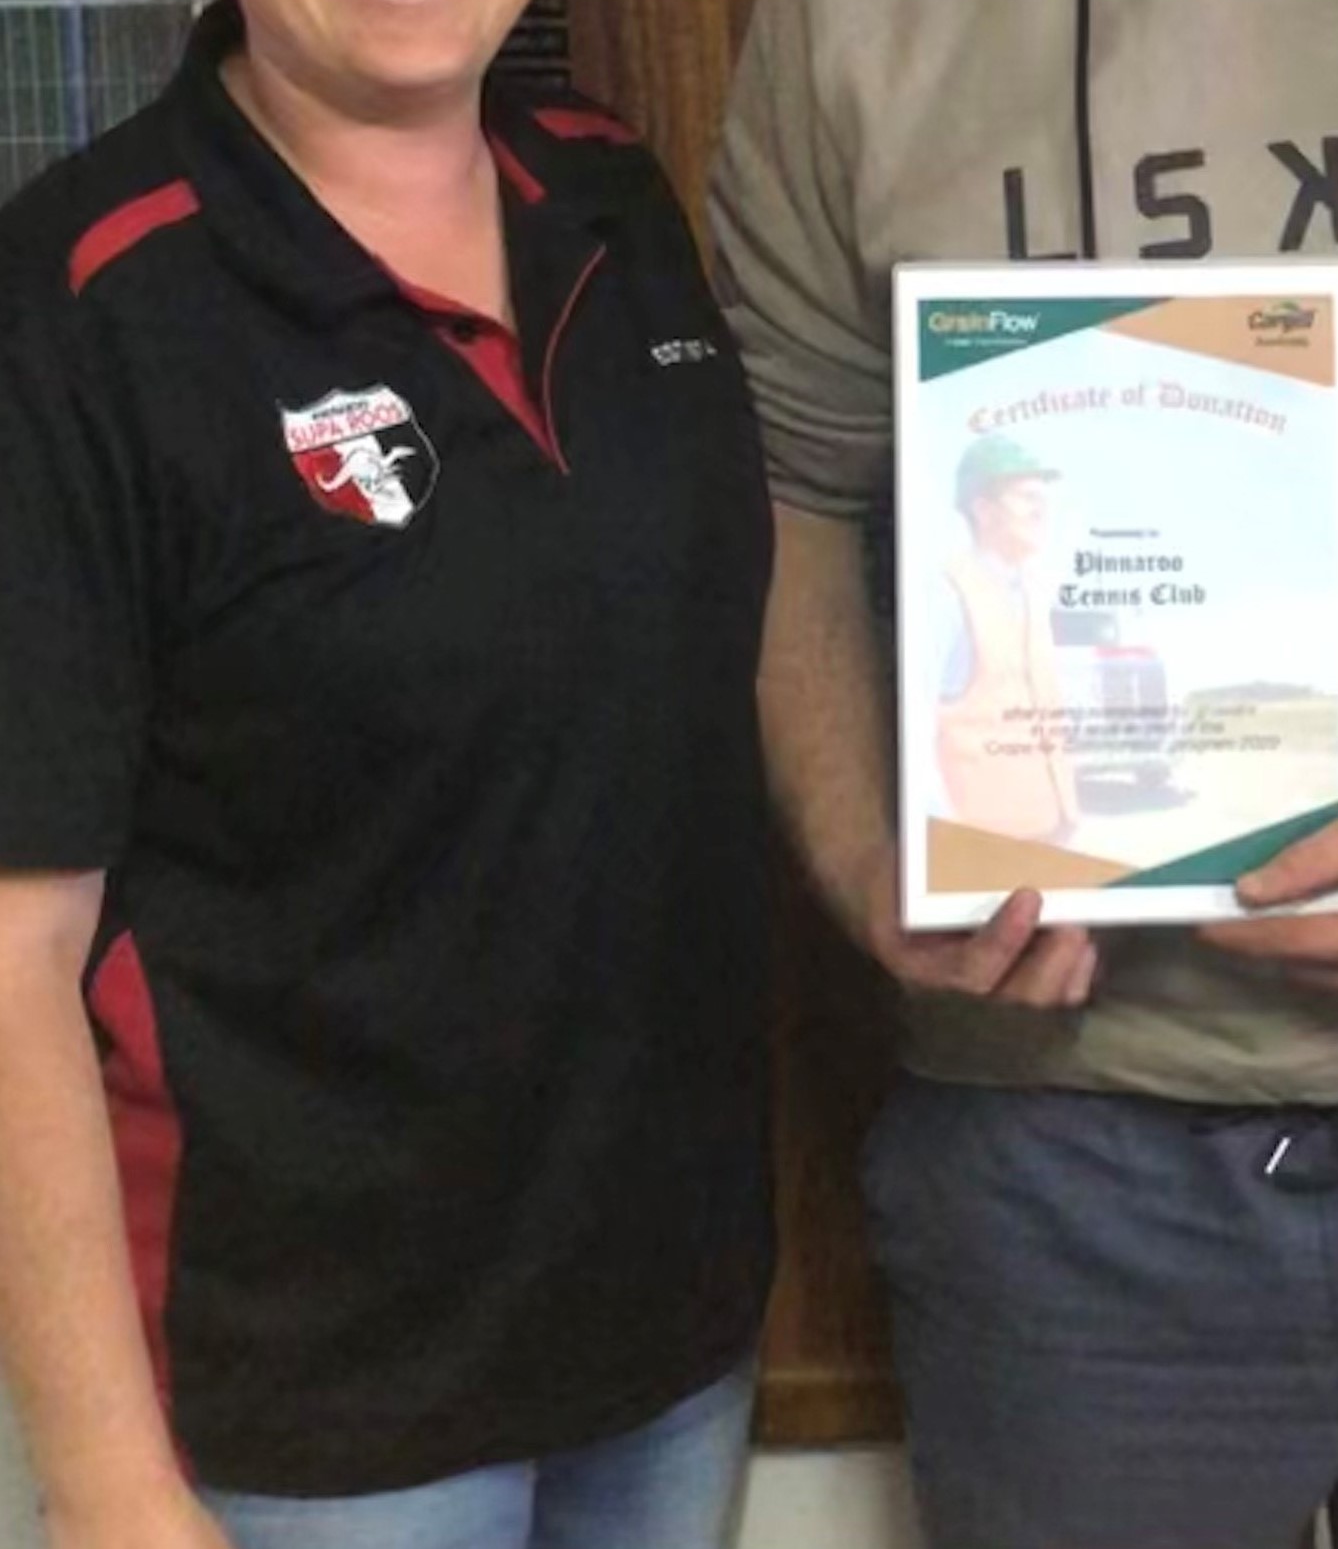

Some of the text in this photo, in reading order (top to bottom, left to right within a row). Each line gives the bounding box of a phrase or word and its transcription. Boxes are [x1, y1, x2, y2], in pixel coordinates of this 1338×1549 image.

[967, 379, 1288, 435] Certificate of Donation
[290, 420, 343, 446] SUPA
[1074, 549, 1184, 577] Pinnaroo
[1058, 583, 1206, 607] Tennis Club
